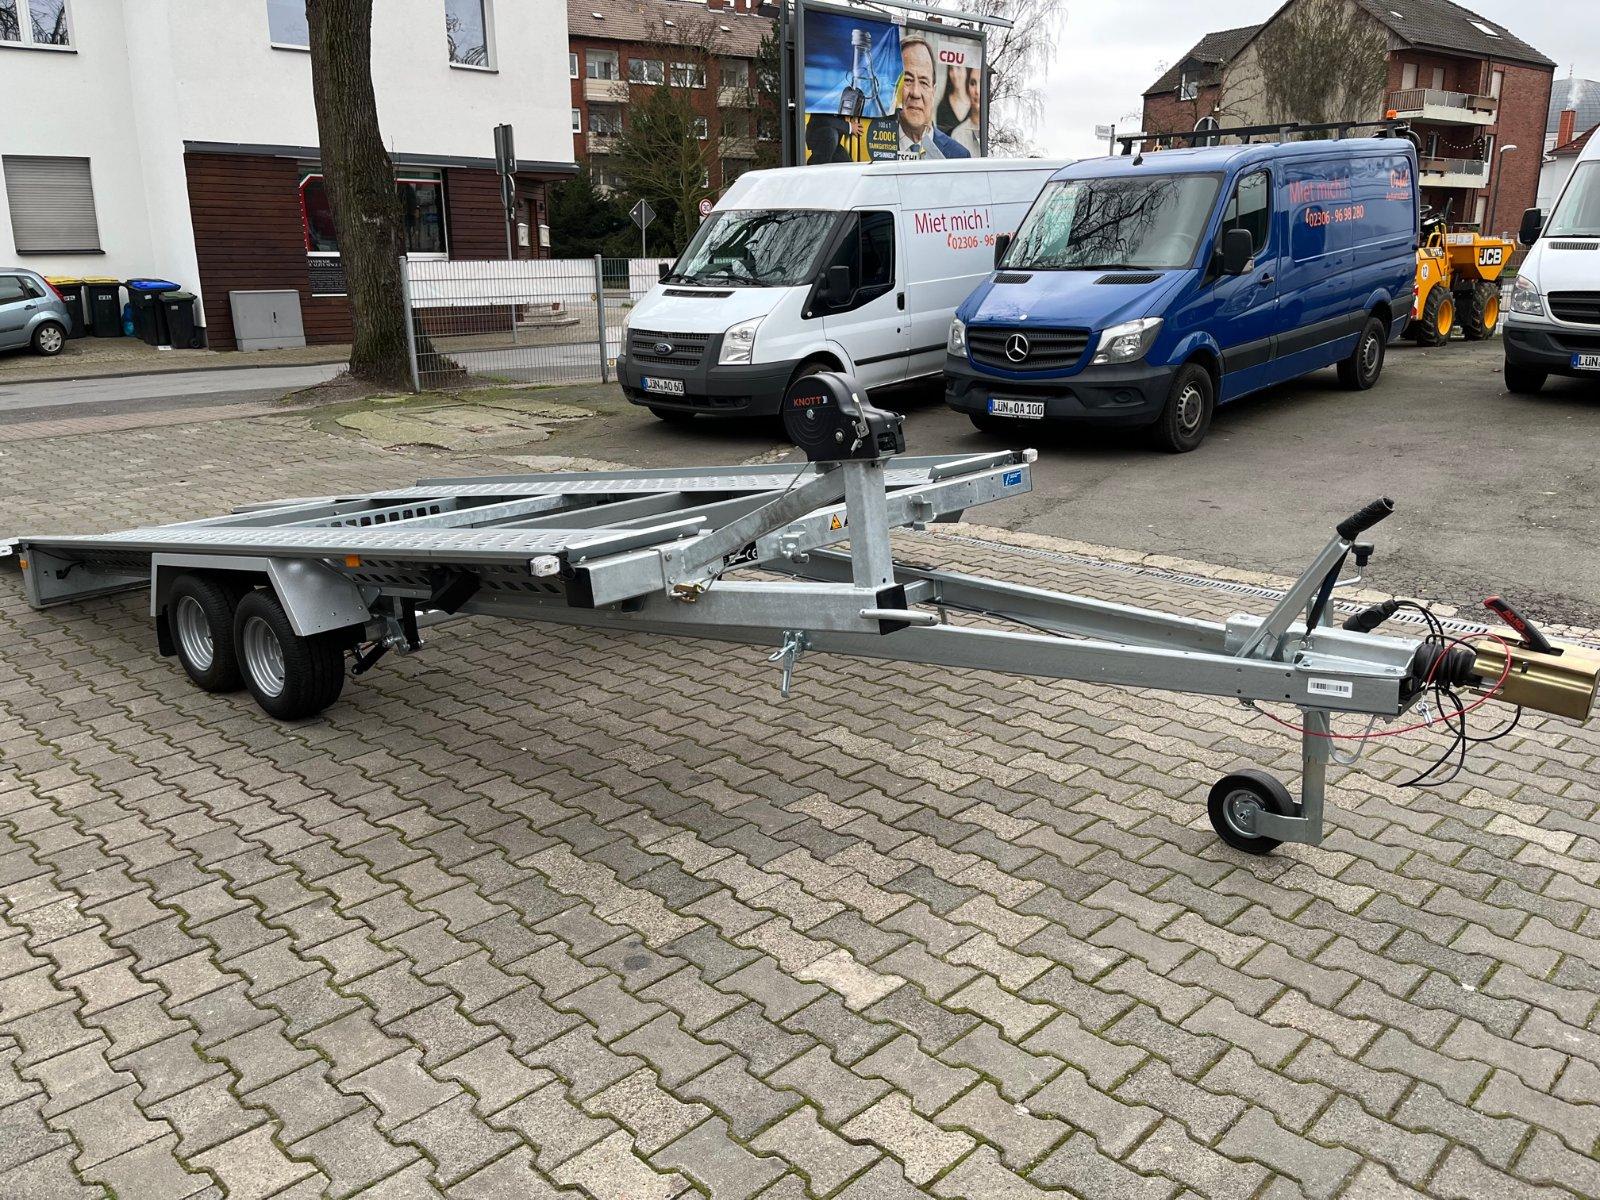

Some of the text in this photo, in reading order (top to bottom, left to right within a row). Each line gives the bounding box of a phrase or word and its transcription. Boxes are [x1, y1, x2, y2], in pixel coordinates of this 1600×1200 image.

[939, 50, 965, 65] CDU
[1289, 181, 1314, 204] Miet
[1317, 178, 1341, 201] mich
[915, 209, 990, 234] Miet mich !
[1309, 210, 1330, 227] 02306
[1334, 208, 1343, 223] 96
[1352, 205, 1364, 220] 280
[952, 236, 978, 249] 02306
[984, 234, 995, 247] 96
[1479, 248, 1502, 265] JCB
[1579, 355, 1598, 366] LÜN
[793, 396, 821, 407] KNOTT
[993, 401, 1043, 415] LÜN OA 100
